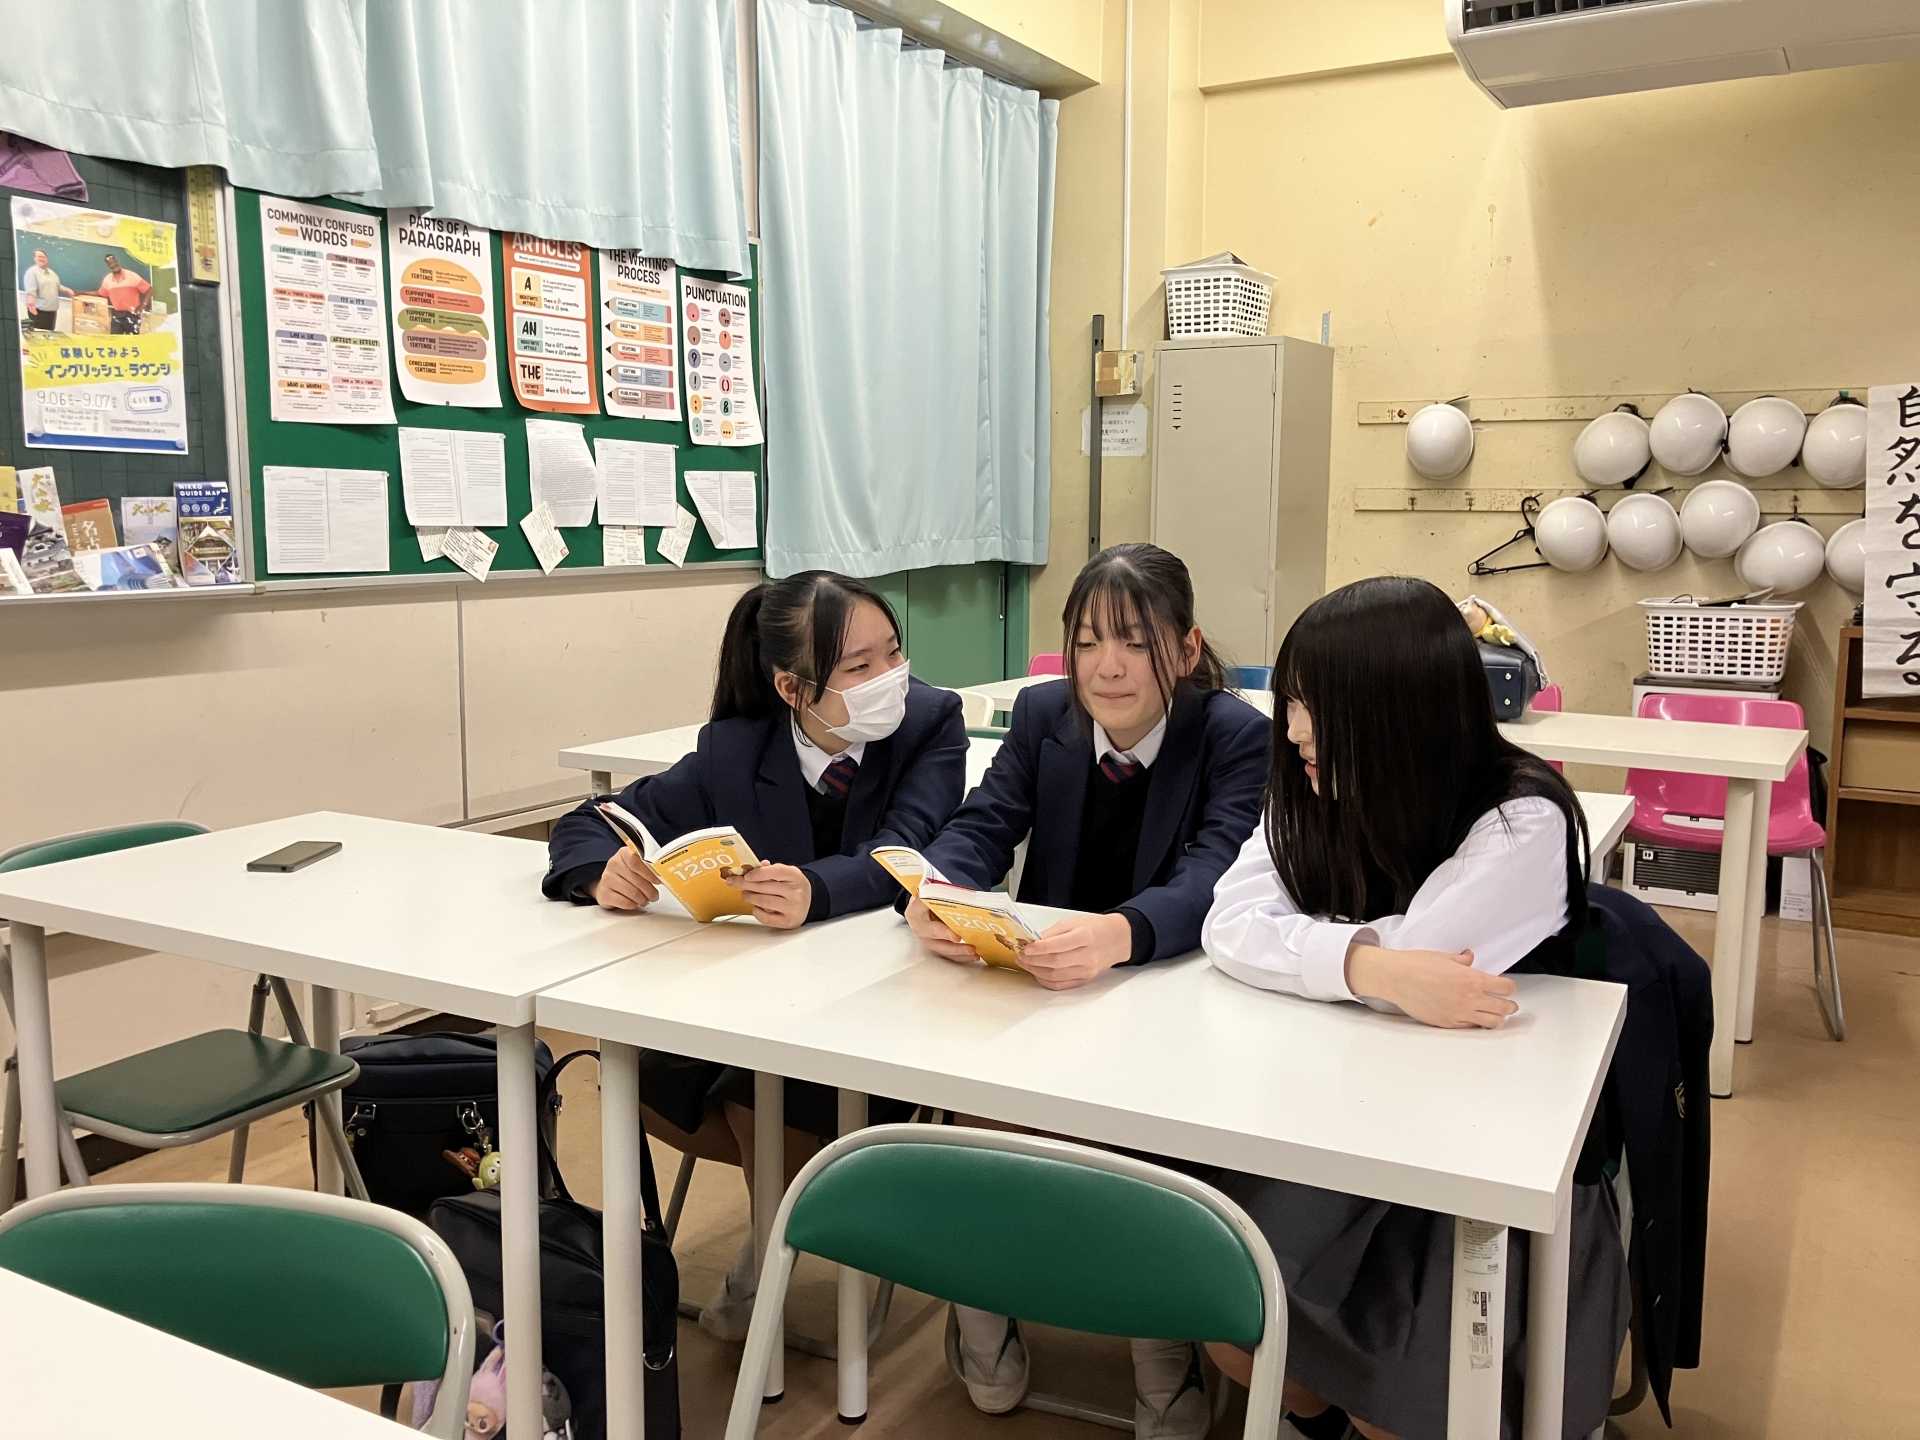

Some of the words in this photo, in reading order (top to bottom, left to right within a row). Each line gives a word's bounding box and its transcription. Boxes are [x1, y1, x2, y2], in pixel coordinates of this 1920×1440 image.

[267, 208, 323, 228] COMMONLY
[325, 218, 375, 237] CONFUSED
[409, 214, 444, 233] PARTS
[446, 221, 460, 235] OF
[462, 224, 470, 237] A
[300, 226, 348, 247] WORDS
[399, 227, 481, 257] PARAGRAPH
[512, 232, 582, 261] ARTICLES
[608, 249, 627, 263] THE
[629, 249, 668, 272] WRITING
[524, 276, 532, 291] A
[617, 265, 660, 285] PROCESS
[685, 285, 746, 308] PUNCTUATION
[522, 320, 537, 336] AN
[520, 363, 541, 380] THE
[673, 854, 734, 881] 1200
